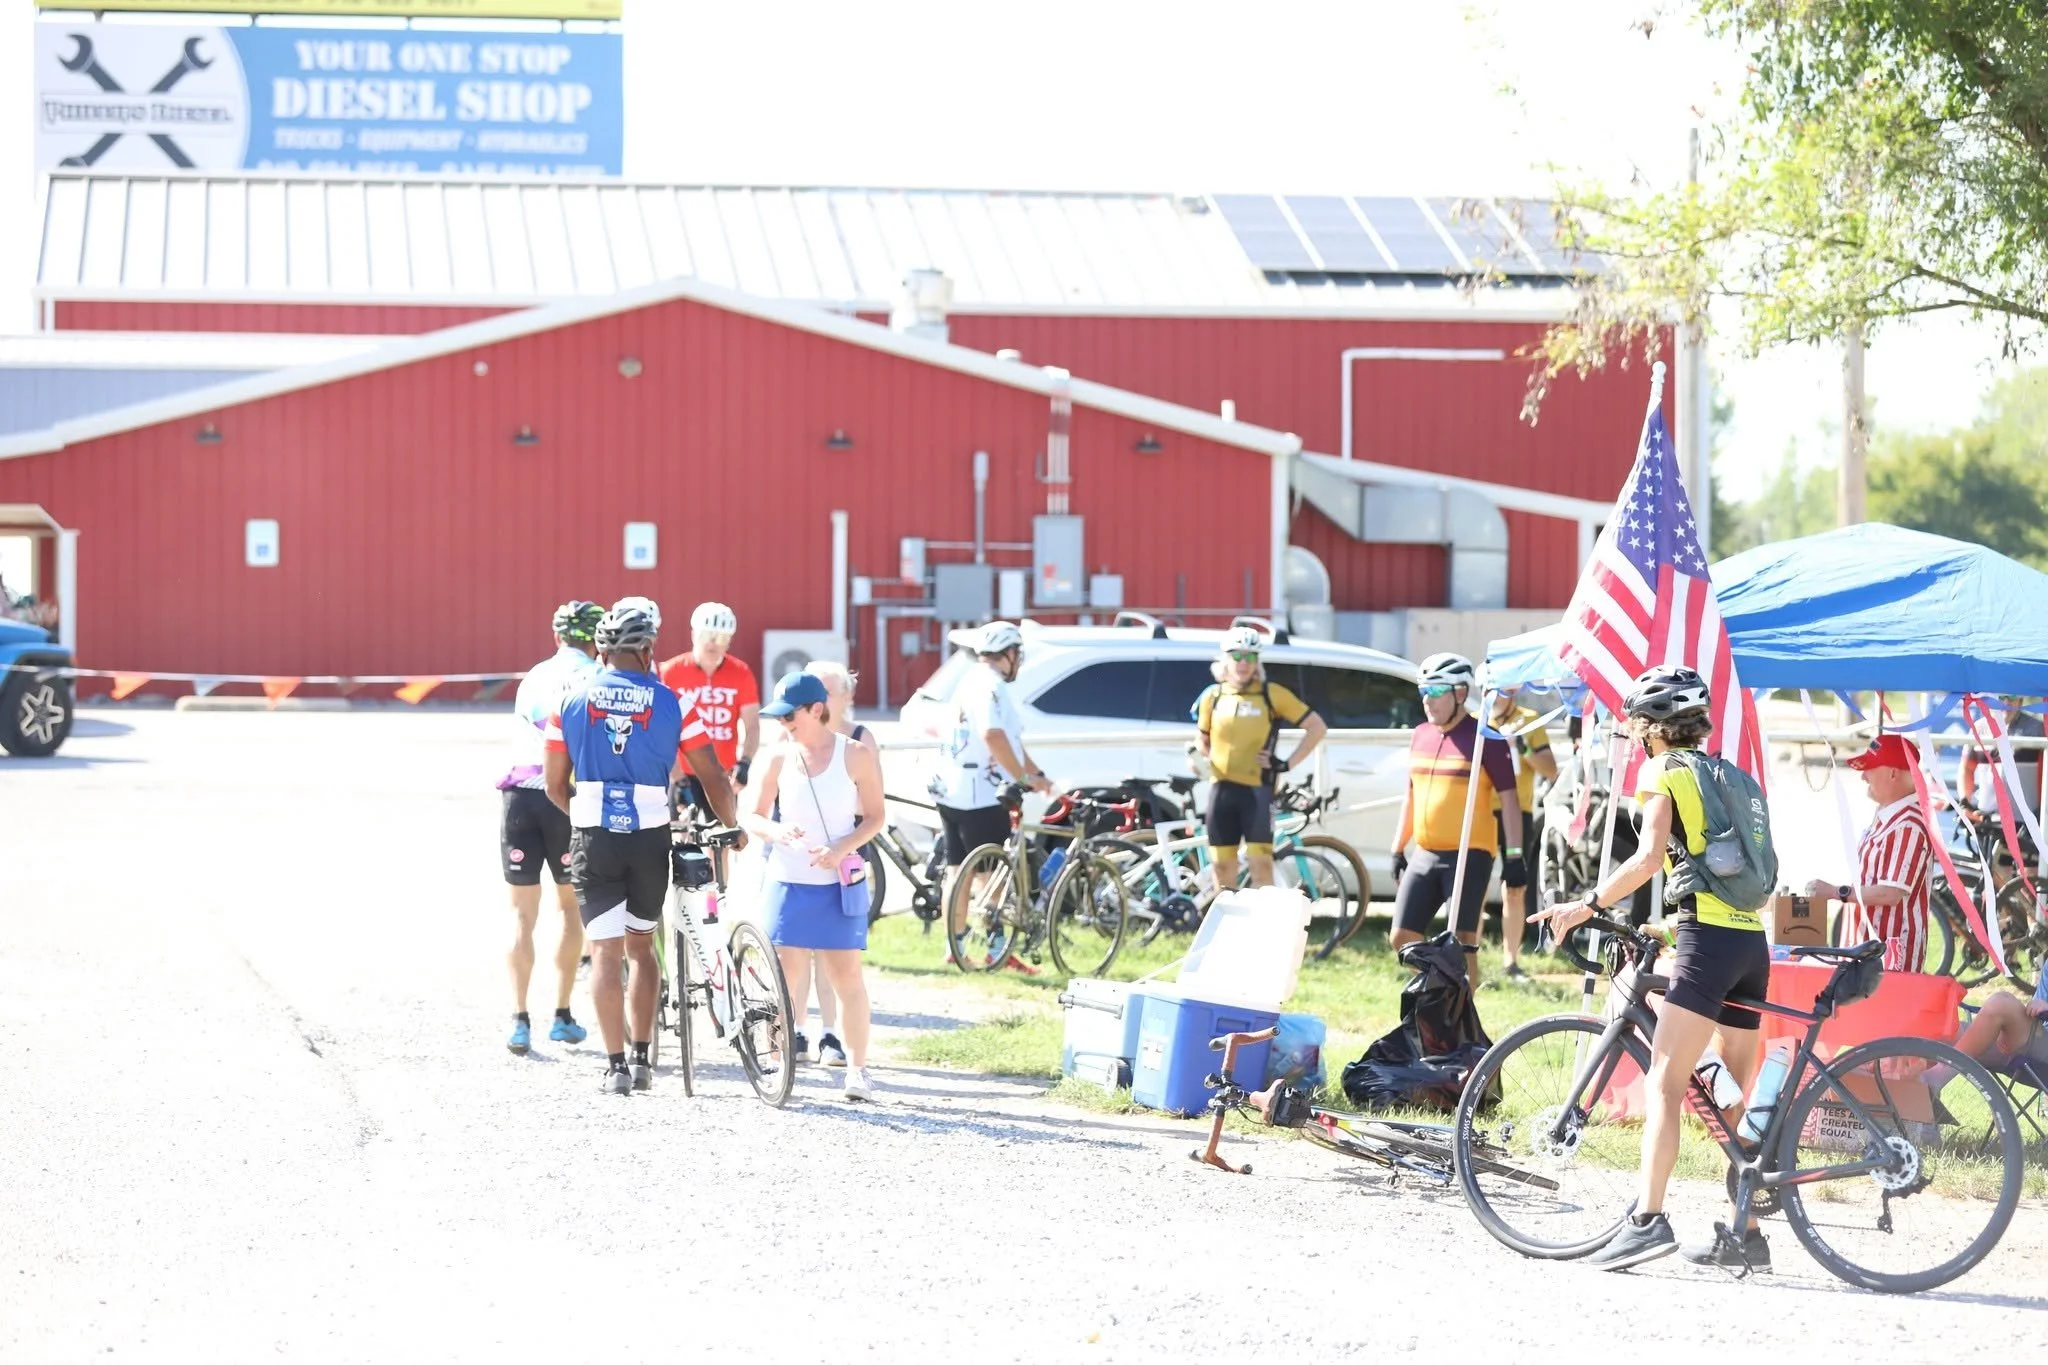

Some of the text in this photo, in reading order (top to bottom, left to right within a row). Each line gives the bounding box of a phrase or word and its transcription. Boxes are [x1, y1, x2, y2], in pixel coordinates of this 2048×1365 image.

[295, 39, 572, 76] YOUR ONE STOP
[271, 77, 593, 124] DIESEL SHOP
[588, 686, 655, 706] COWTOWN
[677, 686, 738, 706] WEST
[595, 699, 644, 712] OKLAHOMA
[695, 706, 732, 725] ND
[609, 815, 632, 826] exp
[1466, 1105, 1473, 1118] DT
[1823, 1107, 1846, 1117] TEES
[1821, 1118, 1865, 1130] CREATED
